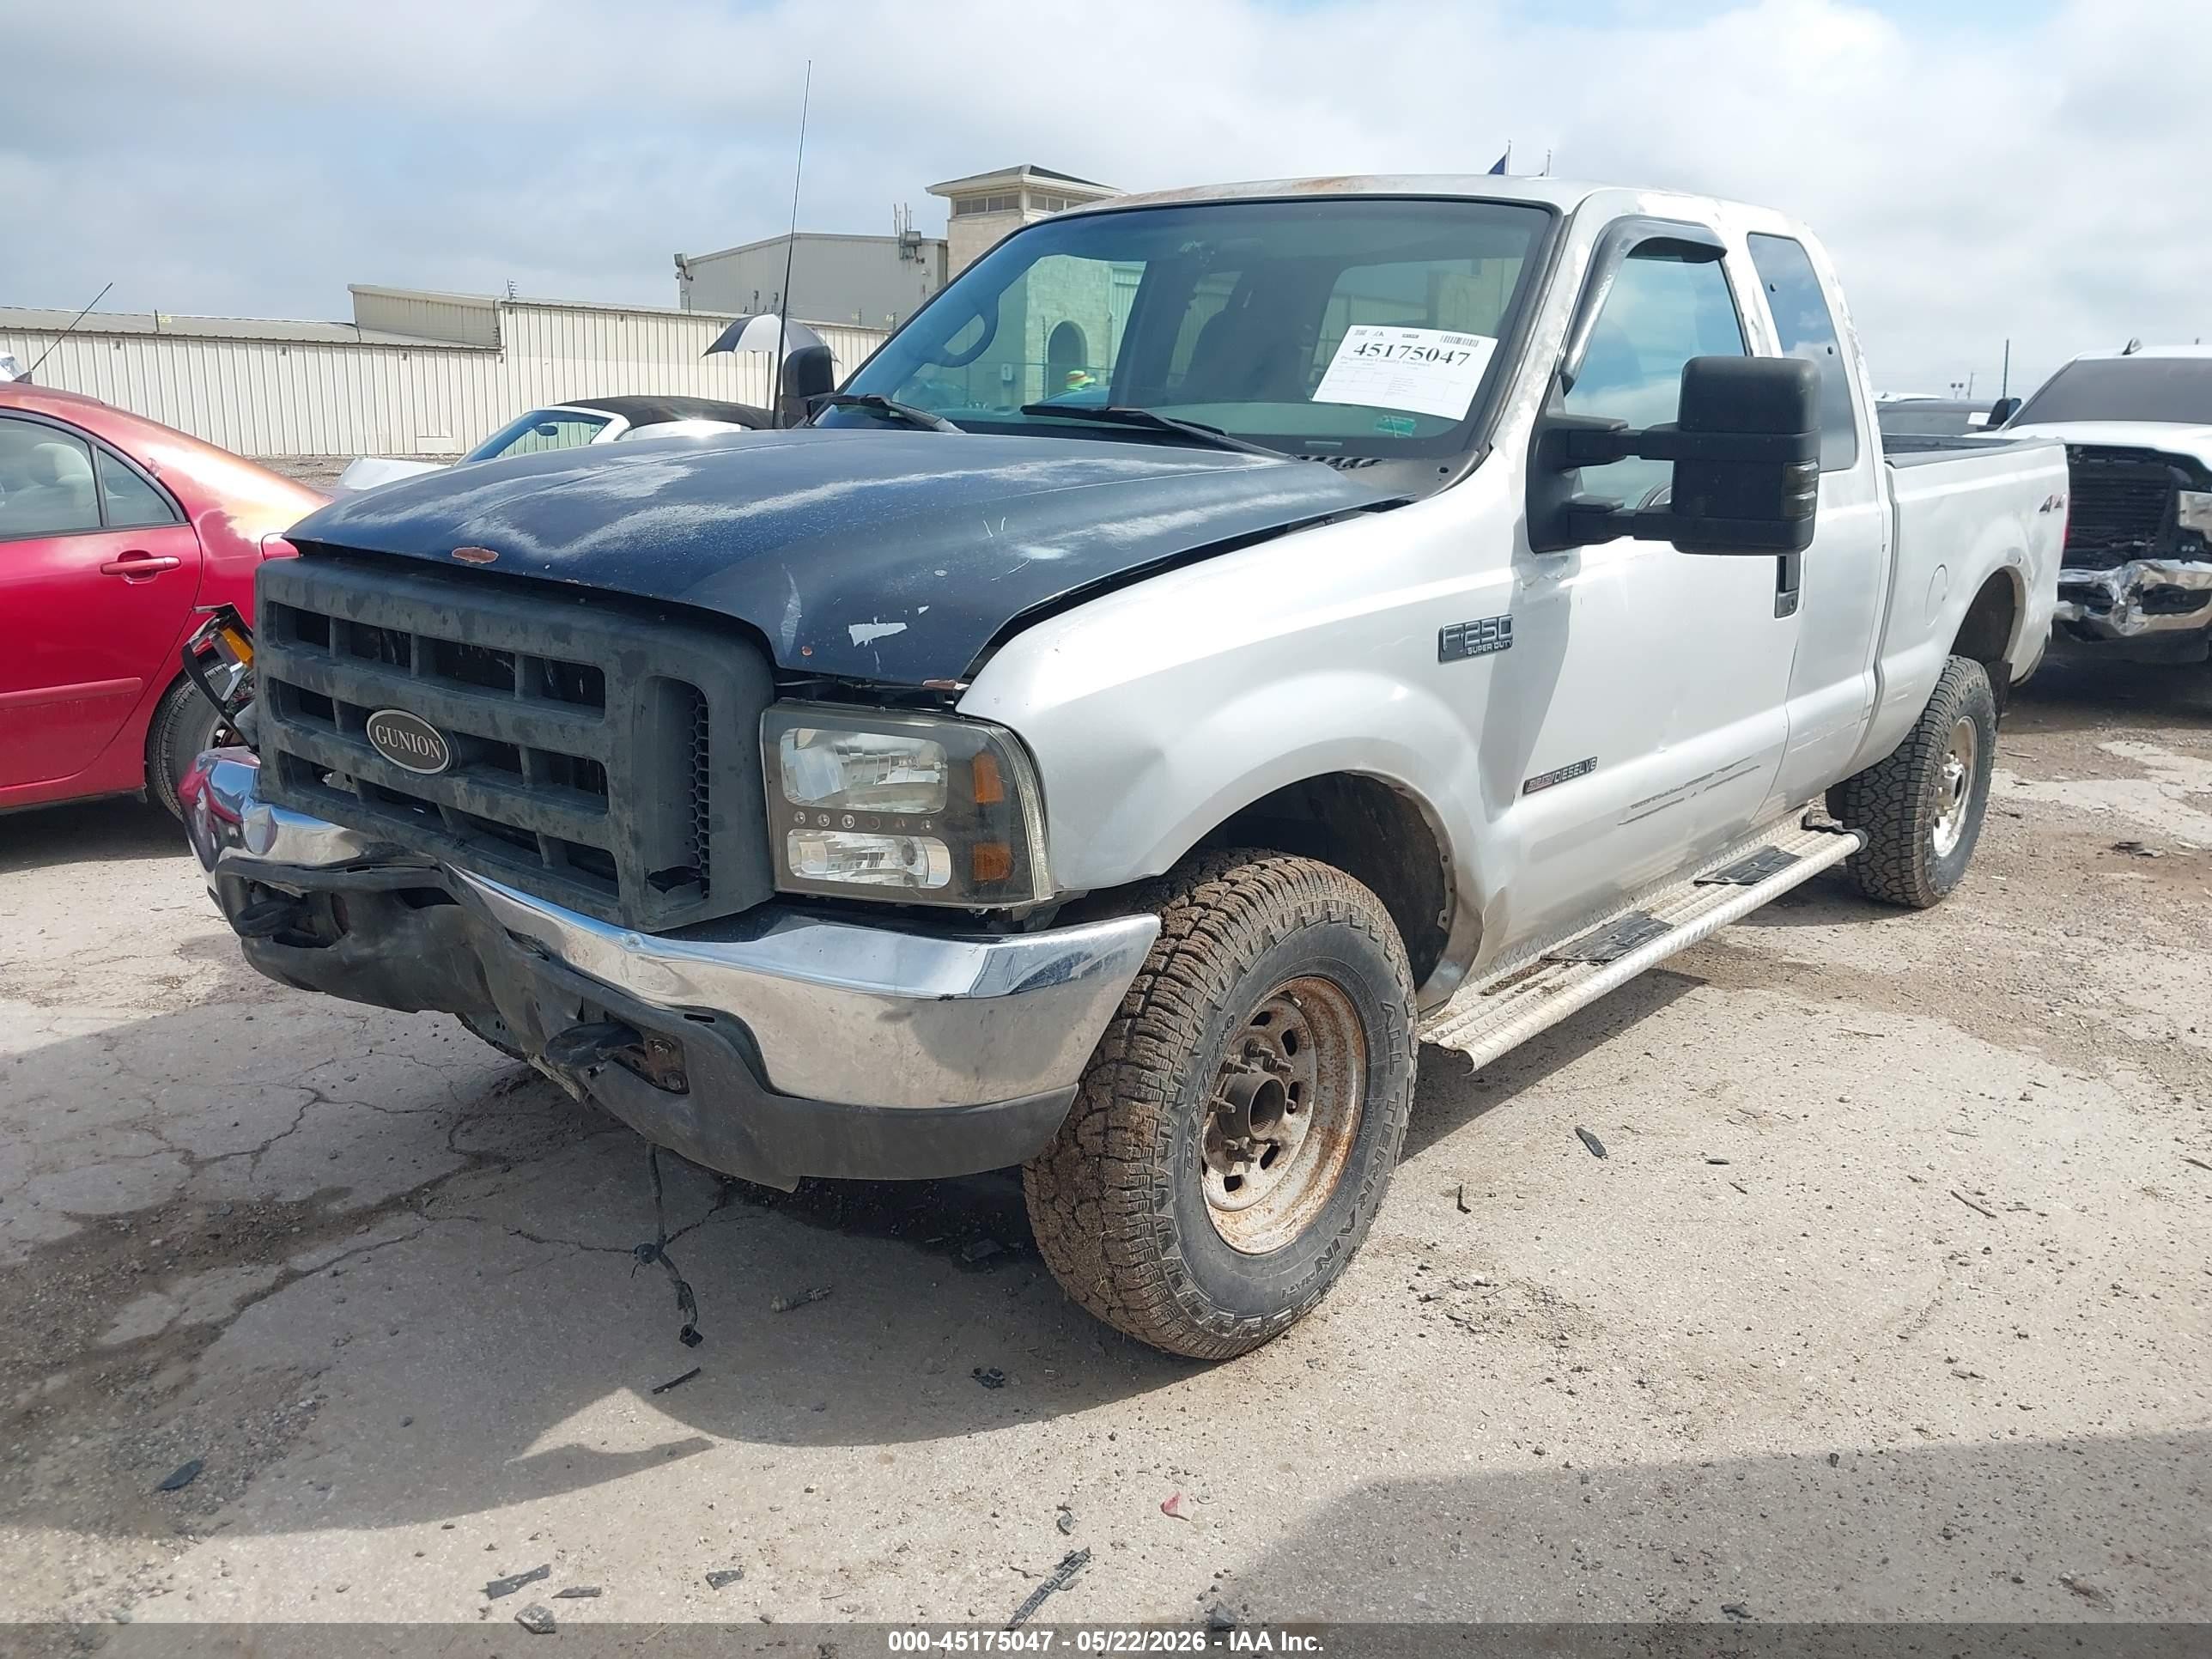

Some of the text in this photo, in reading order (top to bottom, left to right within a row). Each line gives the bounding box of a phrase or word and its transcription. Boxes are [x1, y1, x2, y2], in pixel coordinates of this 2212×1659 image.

[1353, 343, 1471, 367] 45175047
[1467, 639, 1512, 655] SUPER DUTY
[375, 725, 442, 761] GUNION
[1553, 763, 1585, 784] DIESEL
[1380, 1000, 1402, 1076] ALL
[1314, 1091, 1400, 1277] TERRAIN
